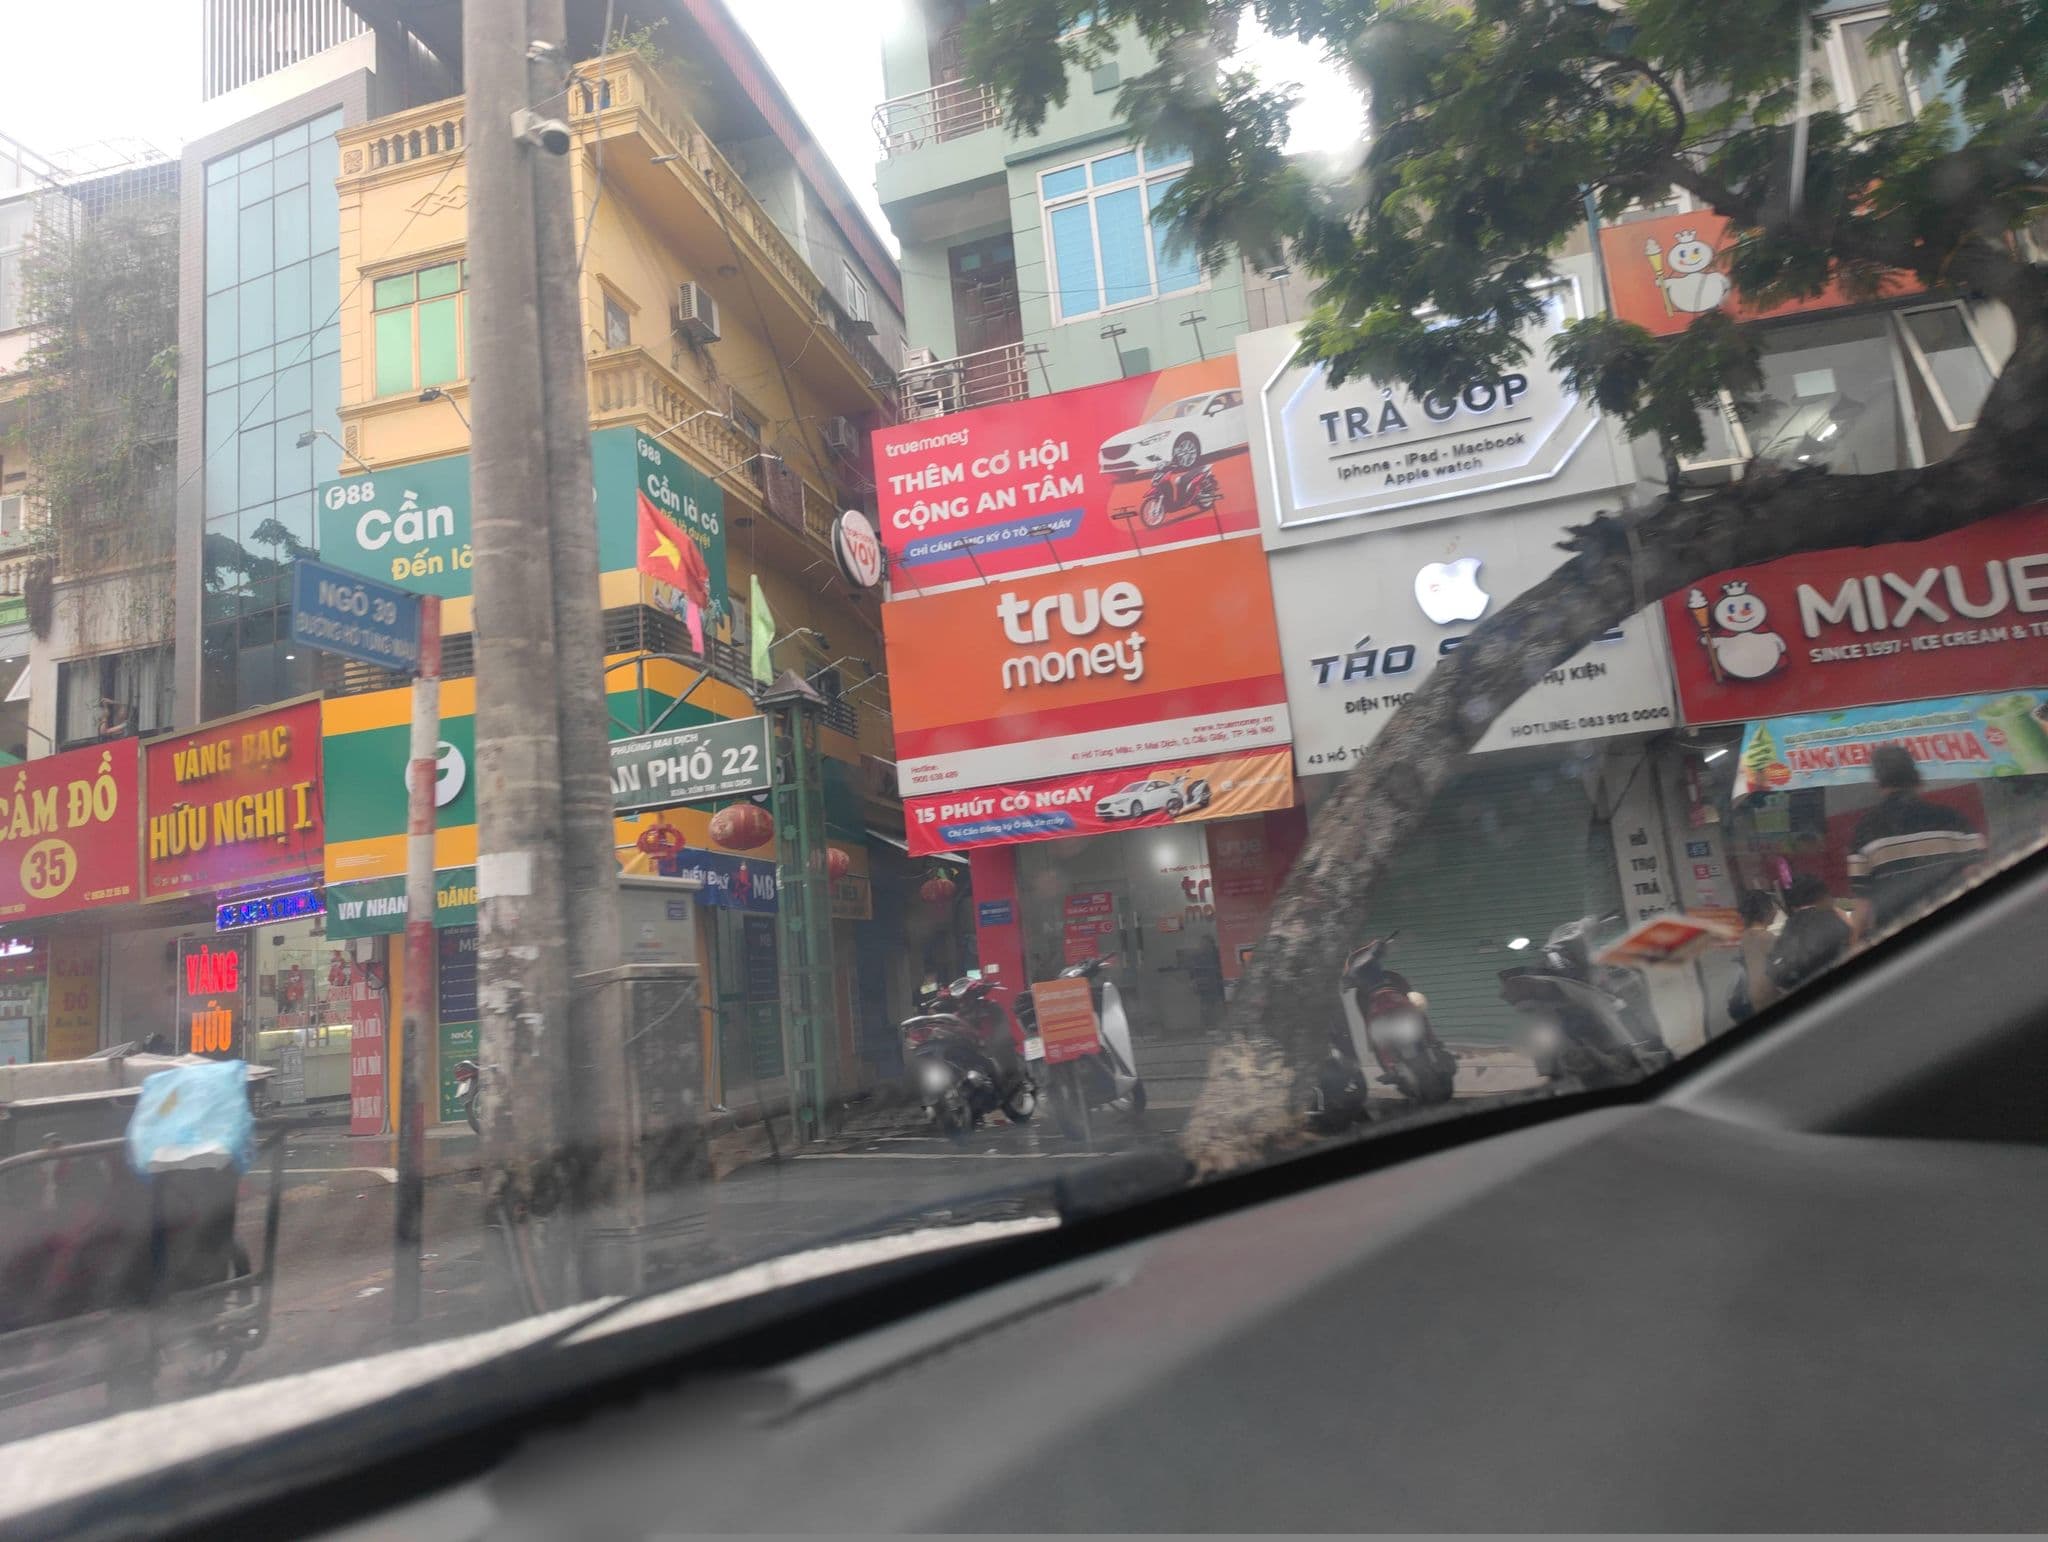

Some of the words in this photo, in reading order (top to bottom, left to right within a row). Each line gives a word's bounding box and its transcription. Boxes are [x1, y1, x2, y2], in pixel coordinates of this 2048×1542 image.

[1320, 387, 1408, 445] TRẢ
[885, 428, 970, 458] truemoney
[1453, 432, 1526, 458] Macbook
[889, 463, 965, 497] THÊM
[971, 450, 1011, 479] CƠ
[1017, 438, 1070, 469] HỘI
[1384, 467, 1429, 487] Apple
[1434, 457, 1483, 477] watch
[325, 482, 375, 511] F88
[356, 489, 454, 550] Cần
[893, 494, 970, 534] CỘNG
[975, 487, 1017, 515] AN
[1022, 474, 1085, 504] TÂM
[391, 547, 444, 581] Đến
[319, 579, 369, 617] NGÕ
[373, 597, 397, 625] 39
[997, 582, 1145, 645] true
[1796, 552, 2048, 639] MIXUE
[1002, 631, 1147, 690] money
[1310, 635, 1417, 685] TÁO
[1809, 641, 1864, 664] SINCE
[1865, 639, 1902, 657] 1997
[1911, 634, 1940, 651] ICE
[1942, 626, 2008, 648] CREAM
[1541, 668, 1567, 688] HỤ
[1571, 662, 1607, 683] KIỆN
[1344, 697, 1379, 714] ĐIỆN
[1510, 719, 1577, 738] HOTLINE:
[173, 740, 232, 783] VÀNG
[242, 724, 288, 769] BẠC
[647, 739, 713, 788] PHỐ
[721, 744, 760, 777] 22
[1890, 731, 1989, 763] ATCHA
[66, 750, 118, 829] ĐỒ
[915, 806, 936, 825] 15
[940, 796, 996, 821] PHÚT
[1000, 789, 1030, 812] CÓ
[1036, 784, 1095, 809] NGAY
[151, 801, 208, 862] HỮU
[213, 787, 288, 846] NGHỊ
[30, 847, 68, 892] 35
[338, 901, 364, 921] VAY
[437, 885, 480, 909] ĐĂNG
[186, 944, 239, 996] VÀNG
[190, 1000, 232, 1053] HỮU
